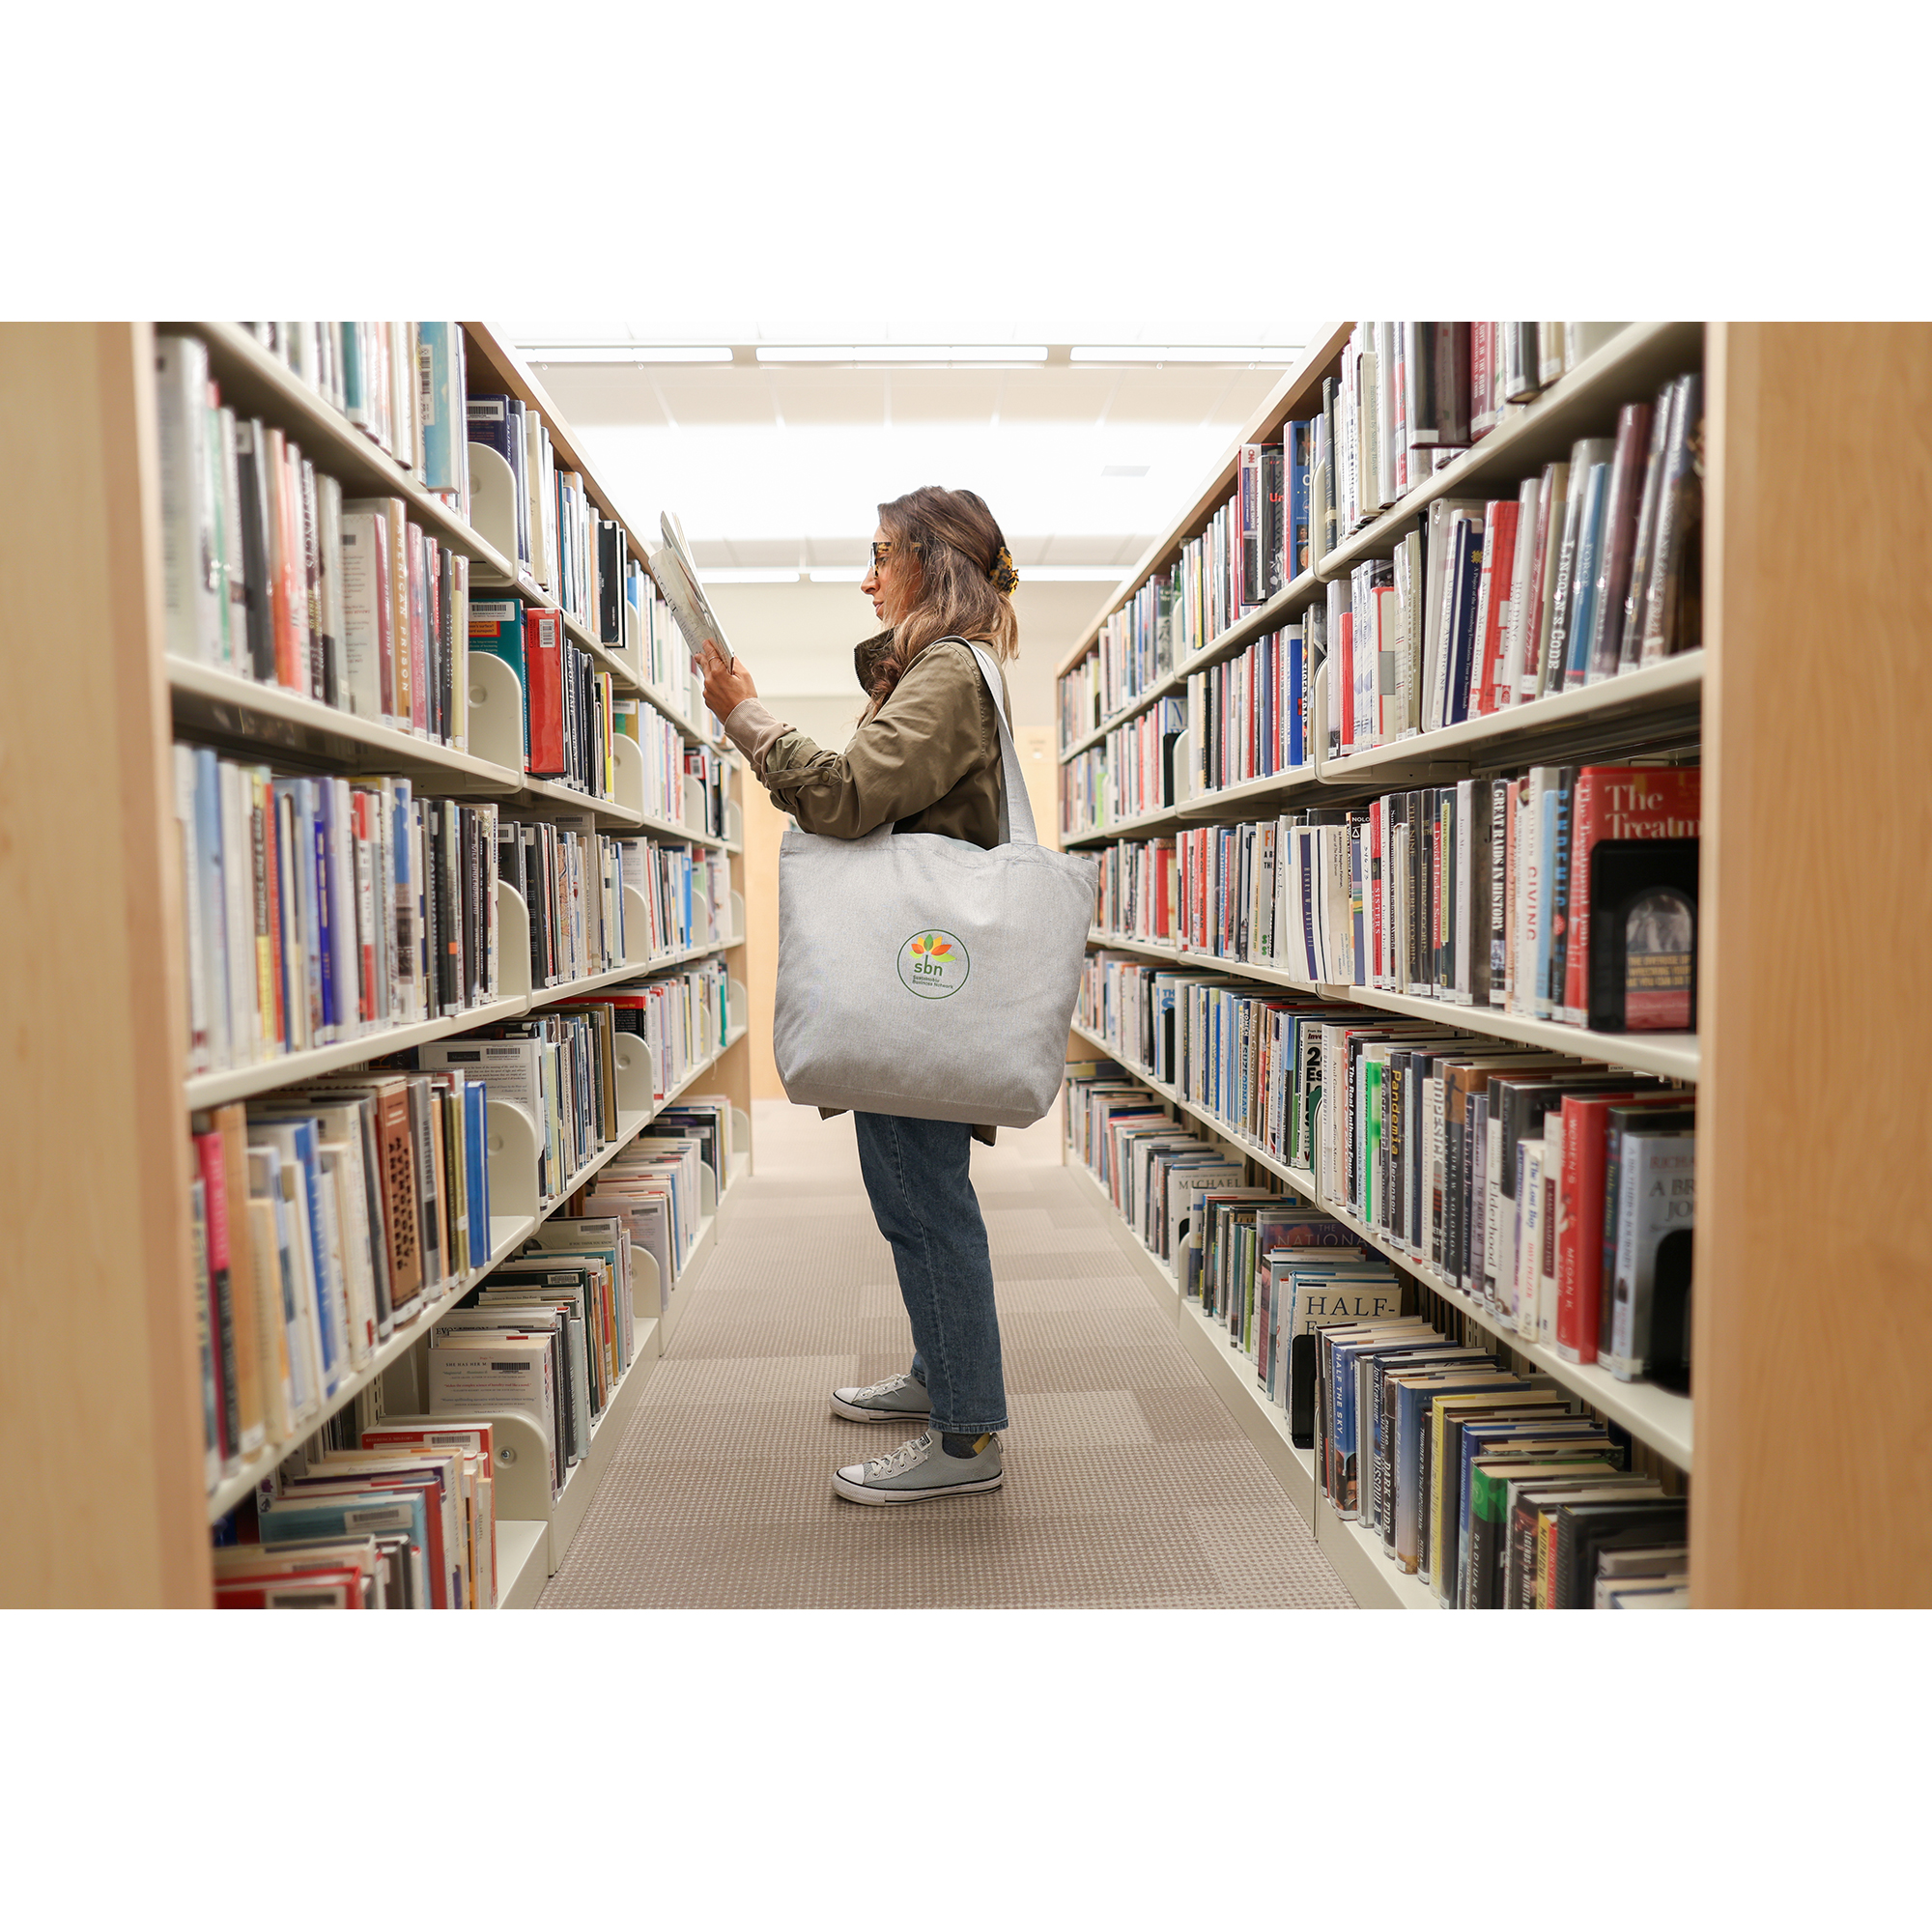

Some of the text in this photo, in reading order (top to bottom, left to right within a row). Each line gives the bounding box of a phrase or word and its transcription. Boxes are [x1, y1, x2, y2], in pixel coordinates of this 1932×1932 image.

[1478, 346, 1485, 355] IN
[397, 525, 410, 692] AMERICAN PRISON
[1548, 539, 1575, 669] LINCOLN'S CODE
[1438, 580, 1454, 691] UNRULY AMERICANS
[1464, 634, 1473, 662] Foundation
[1472, 582, 1487, 682] Allow Me to Retort
[1605, 784, 1663, 810] The
[1432, 830, 1440, 860] David
[1492, 788, 1505, 932] GREAT RAIDS IN HISTORY
[1553, 789, 1569, 907] PANDEMIC
[1304, 867, 1313, 893] HENRY
[1526, 866, 1539, 941] GIVING
[1433, 908, 1441, 942] Souter
[914, 954, 943, 977] sbn
[1392, 1069, 1402, 1155] Pandemia
[1433, 1077, 1444, 1164] DOPESICK
[1530, 1160, 1540, 1179] The
[1568, 1119, 1577, 1184] WOMEN'S
[1179, 1179, 1241, 1190] MICHAEL
[1488, 1180, 1499, 1268] Elderhood
[1526, 1208, 1537, 1230] Boy
[1565, 1247, 1575, 1295] MEGAN
[1306, 1295, 1396, 1316] HALF-
[1373, 1452, 1381, 1513] MISSOULA
[1523, 1530, 1532, 1563] LEGENDS
[1539, 1526, 1548, 1582] MIDNIGHT
[1522, 1574, 1531, 1602] WINTER
